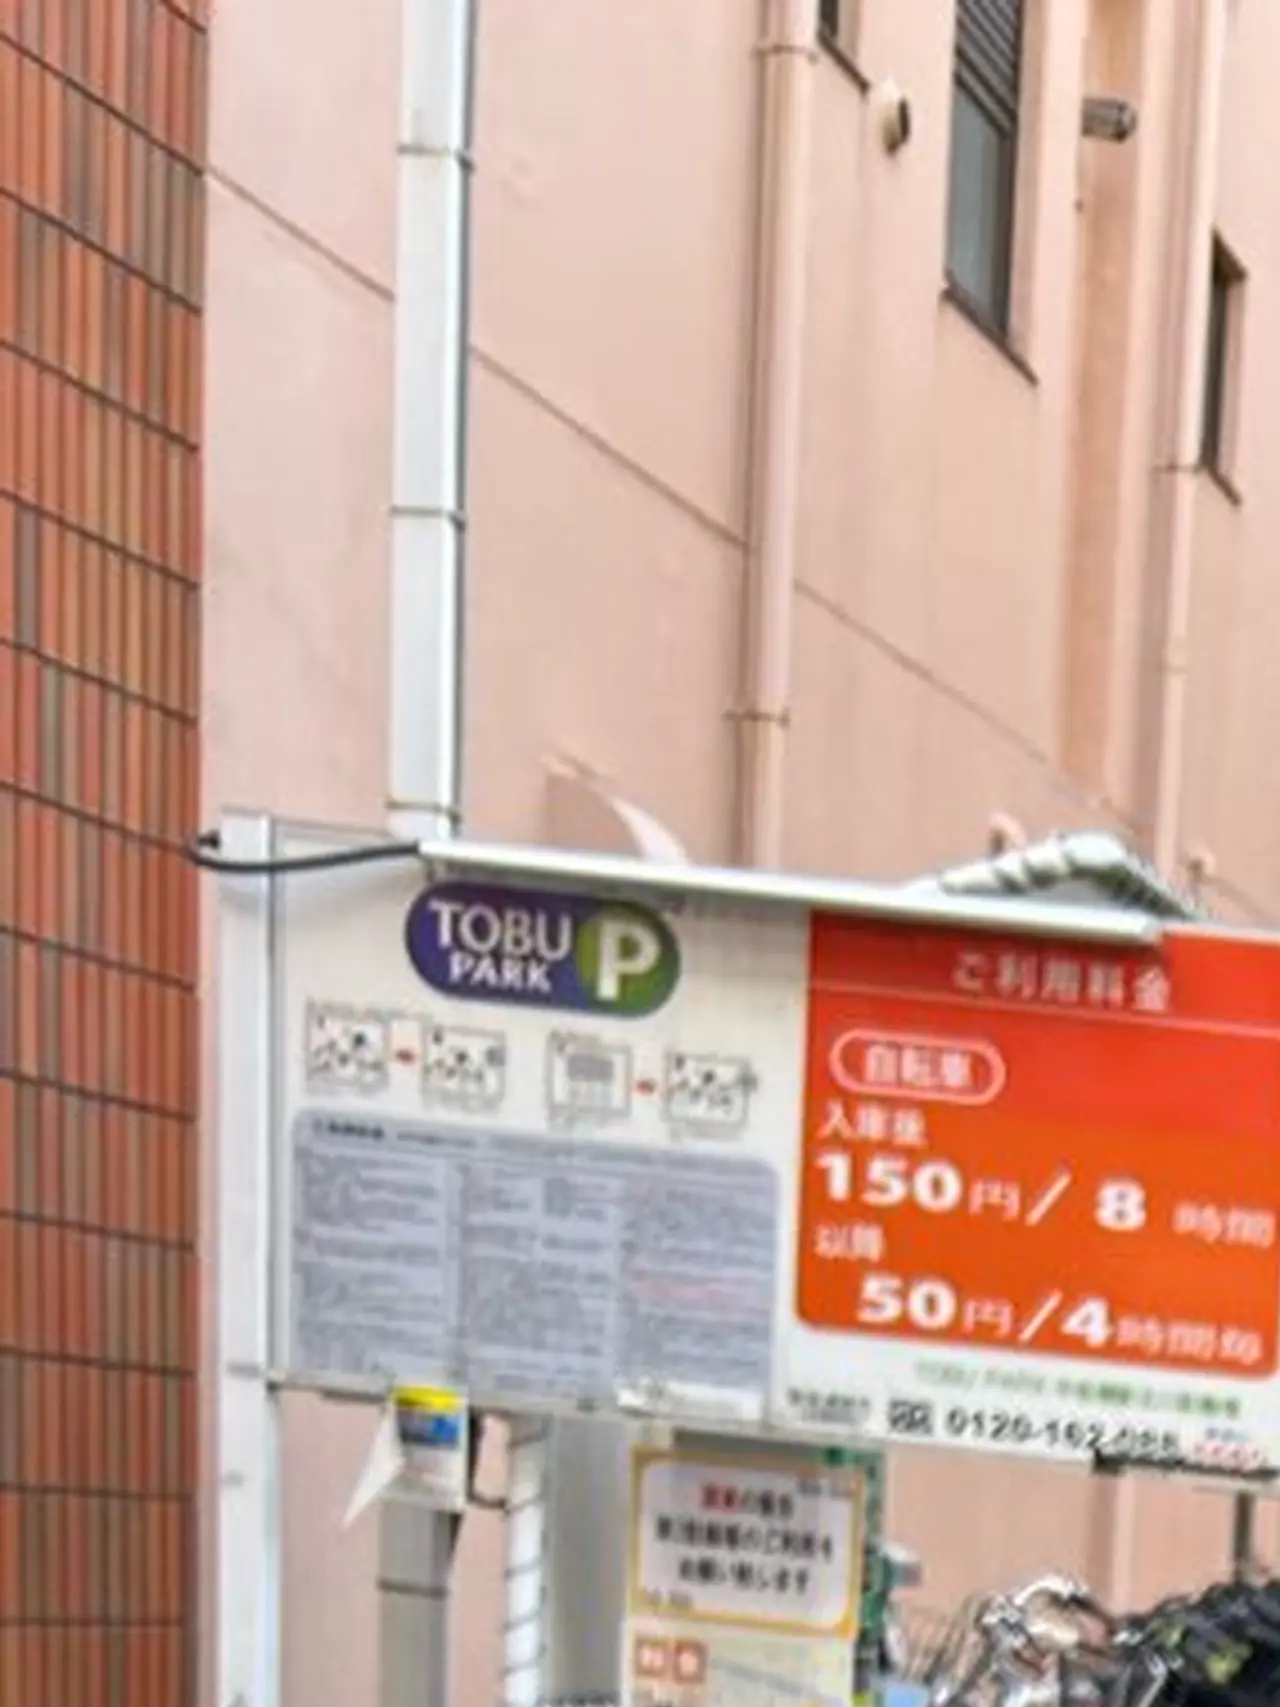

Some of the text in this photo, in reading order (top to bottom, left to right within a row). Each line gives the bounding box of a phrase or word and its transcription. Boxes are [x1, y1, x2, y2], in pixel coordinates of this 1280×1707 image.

[427, 898, 573, 961] TOBU
[449, 950, 552, 994] PARK
[597, 919, 661, 1000] P
[953, 951, 1172, 1012] ご利用料金
[863, 1044, 974, 1087] 自転車
[813, 1222, 884, 1263] 以降
